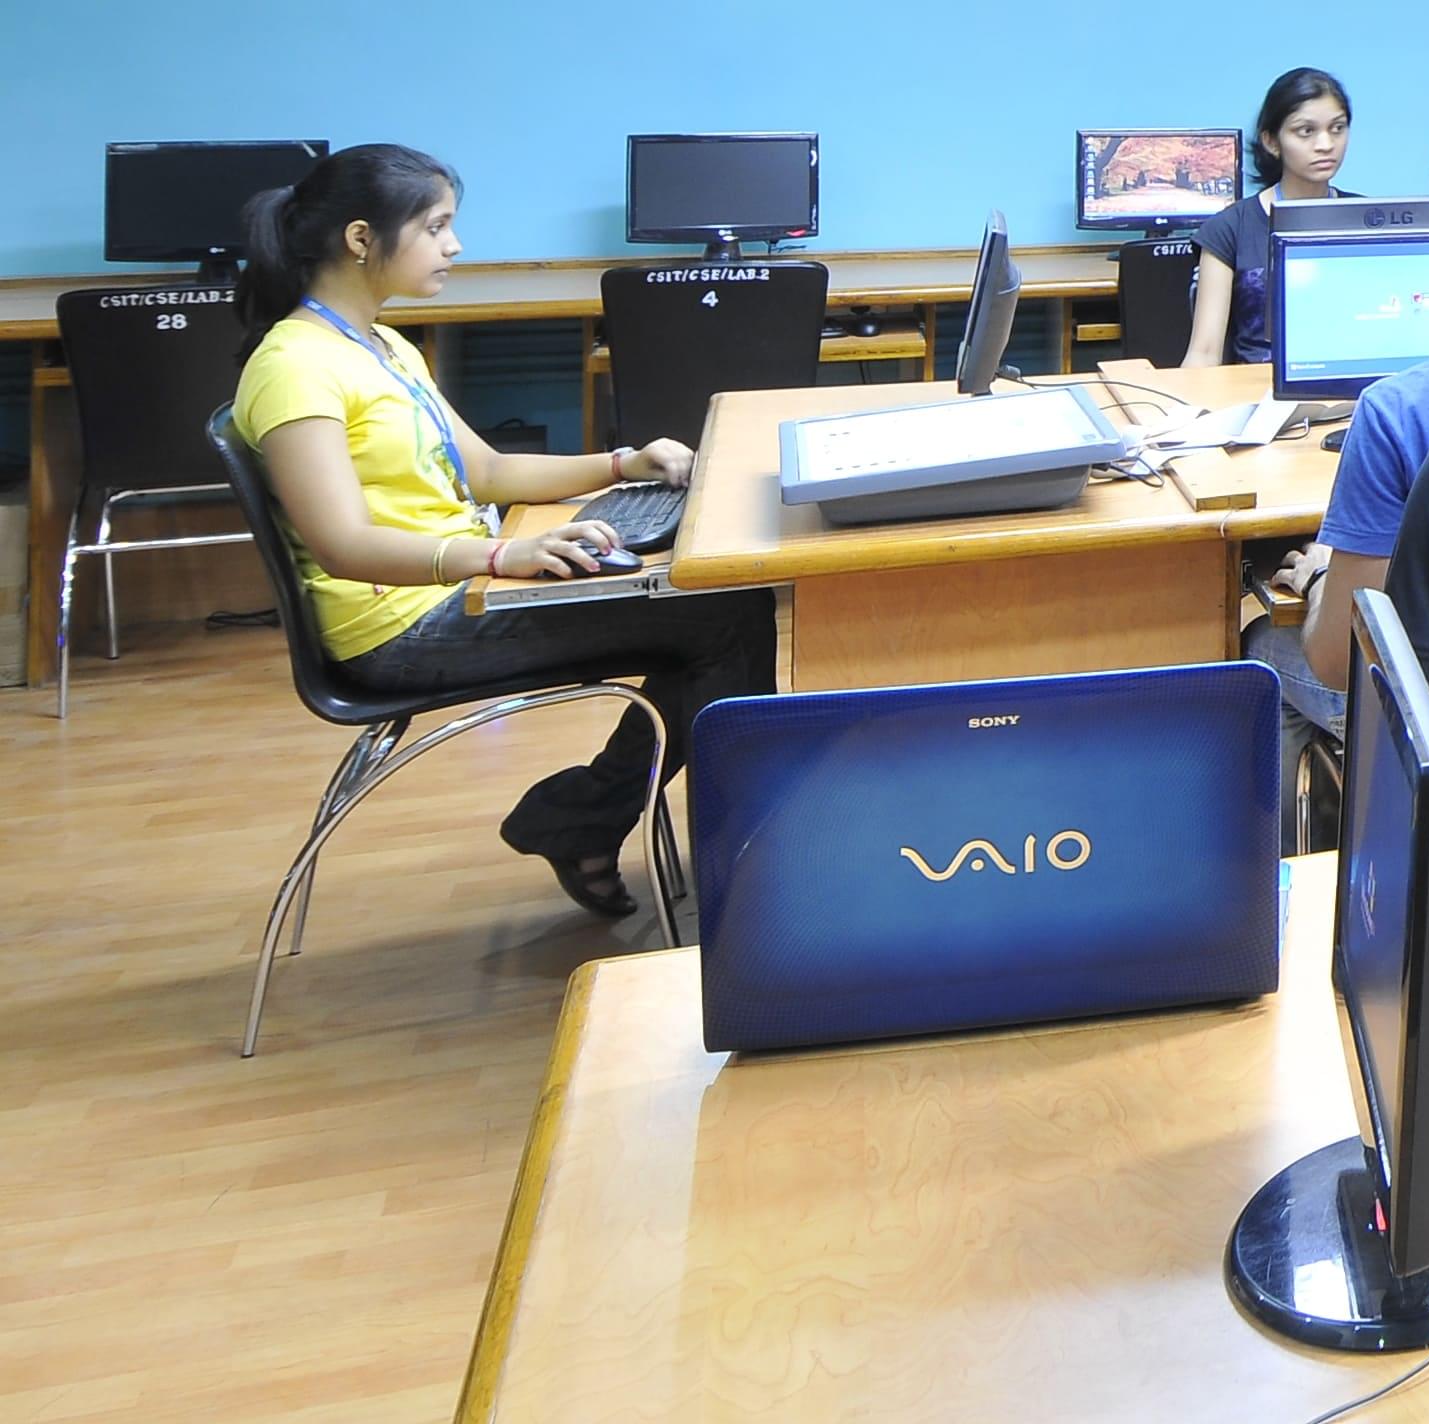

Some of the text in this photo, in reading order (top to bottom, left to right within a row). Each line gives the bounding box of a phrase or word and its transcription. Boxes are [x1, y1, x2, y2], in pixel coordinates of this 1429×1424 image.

[1390, 210, 1414, 225] LG
[702, 290, 719, 307] 4
[156, 313, 188, 330] 28
[968, 715, 1020, 728] SONY
[900, 830, 1091, 881] VAIO
